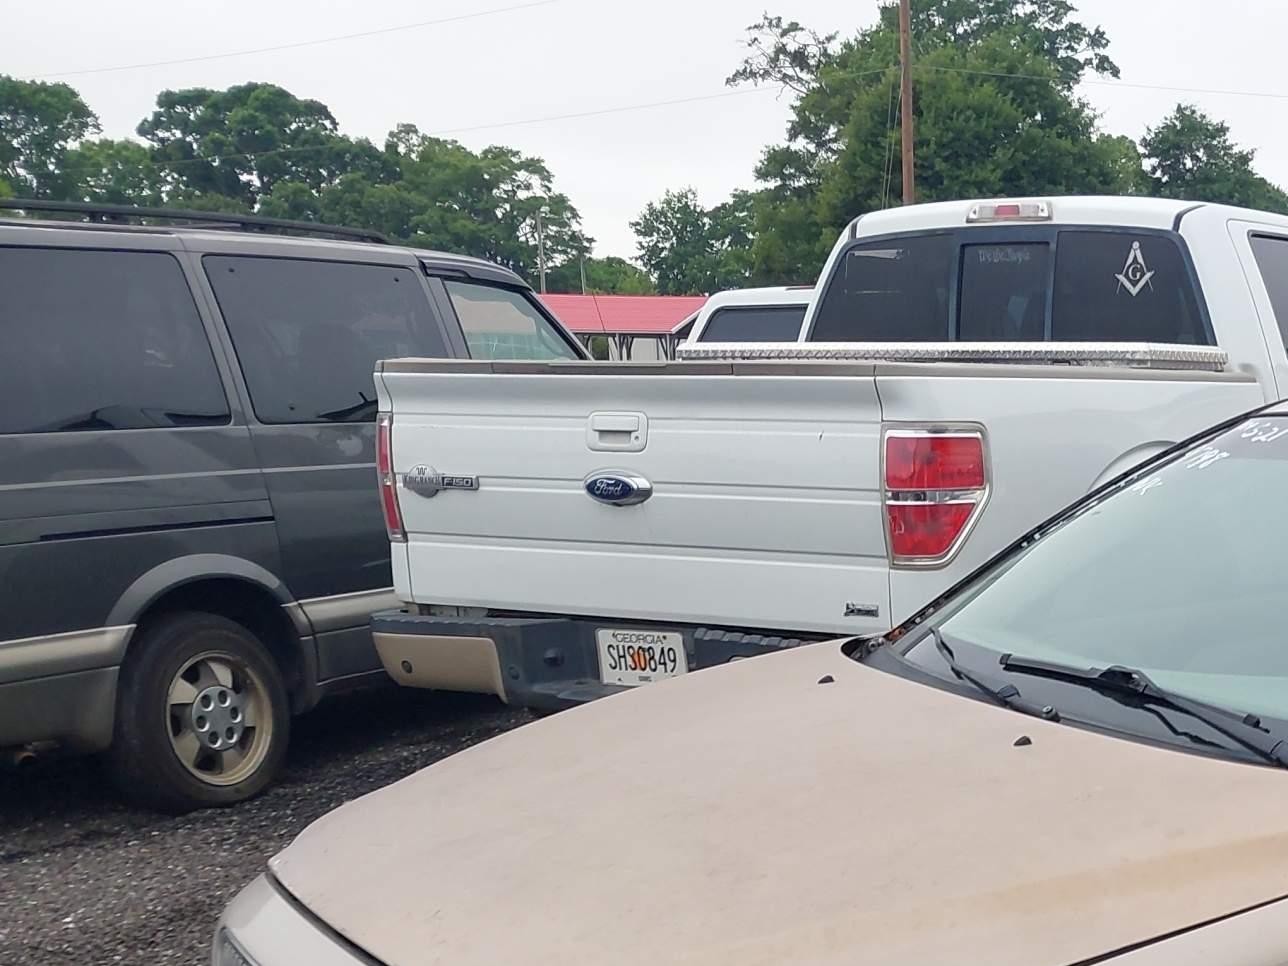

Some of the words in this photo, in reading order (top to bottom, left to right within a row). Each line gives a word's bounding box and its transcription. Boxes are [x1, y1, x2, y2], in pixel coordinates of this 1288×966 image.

[1128, 264, 1141, 280] G
[594, 479, 623, 495] Ford
[615, 633, 664, 645] GEORGIA
